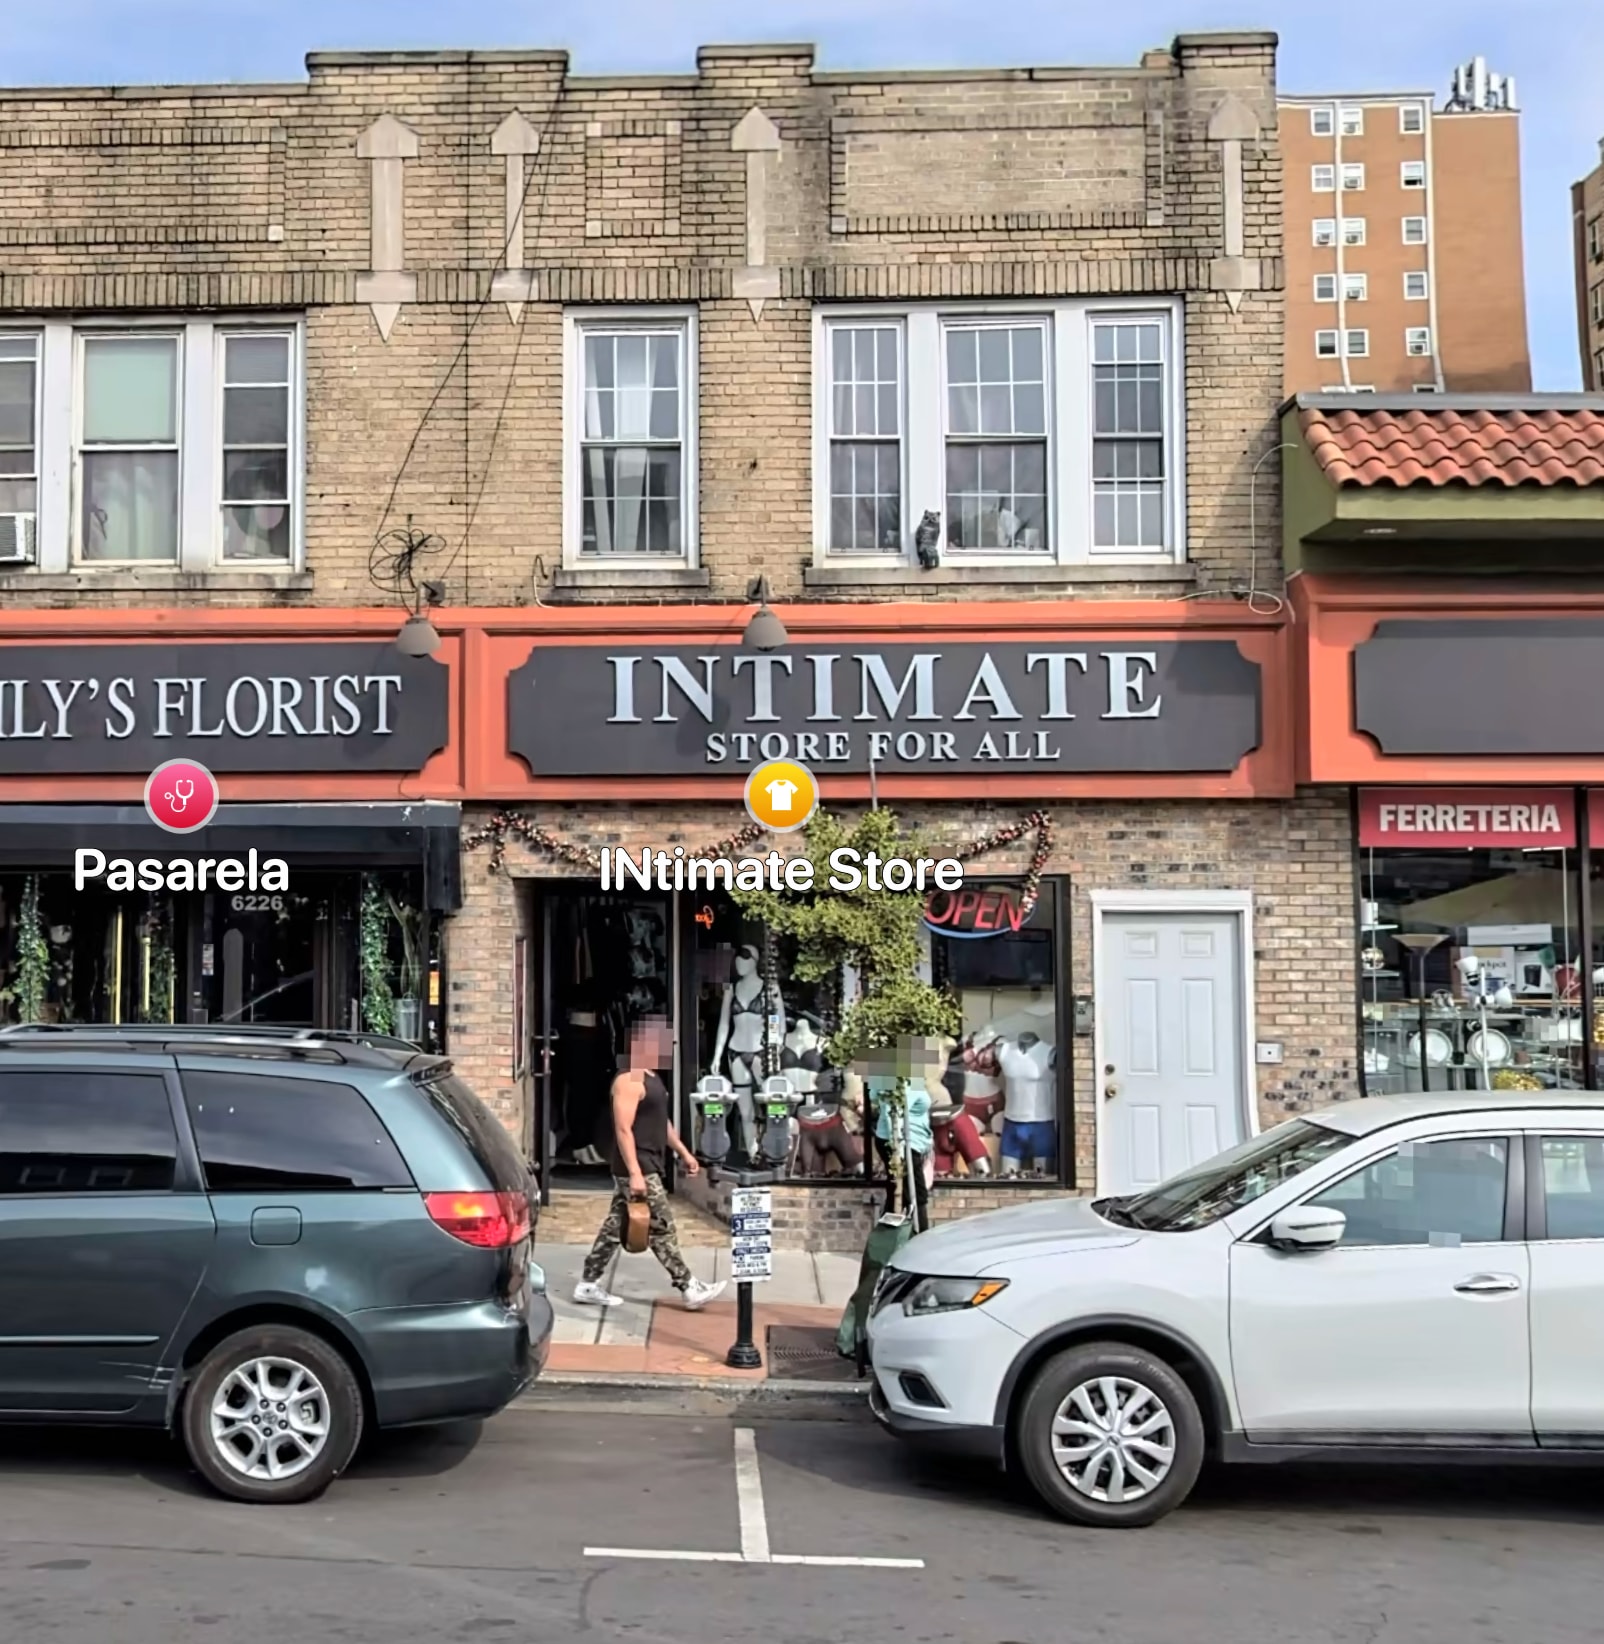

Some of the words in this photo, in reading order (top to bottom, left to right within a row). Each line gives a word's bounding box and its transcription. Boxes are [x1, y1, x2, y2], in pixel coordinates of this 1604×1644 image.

[606, 651, 1162, 722] INTIMATE
[154, 675, 402, 737] FLORIST
[706, 732, 851, 762] STORE
[869, 731, 959, 760] FOR
[972, 731, 1061, 759] ALL
[1379, 804, 1561, 833] FERRETERIA
[231, 895, 283, 911] 6226
[925, 888, 1025, 932] OPEN
